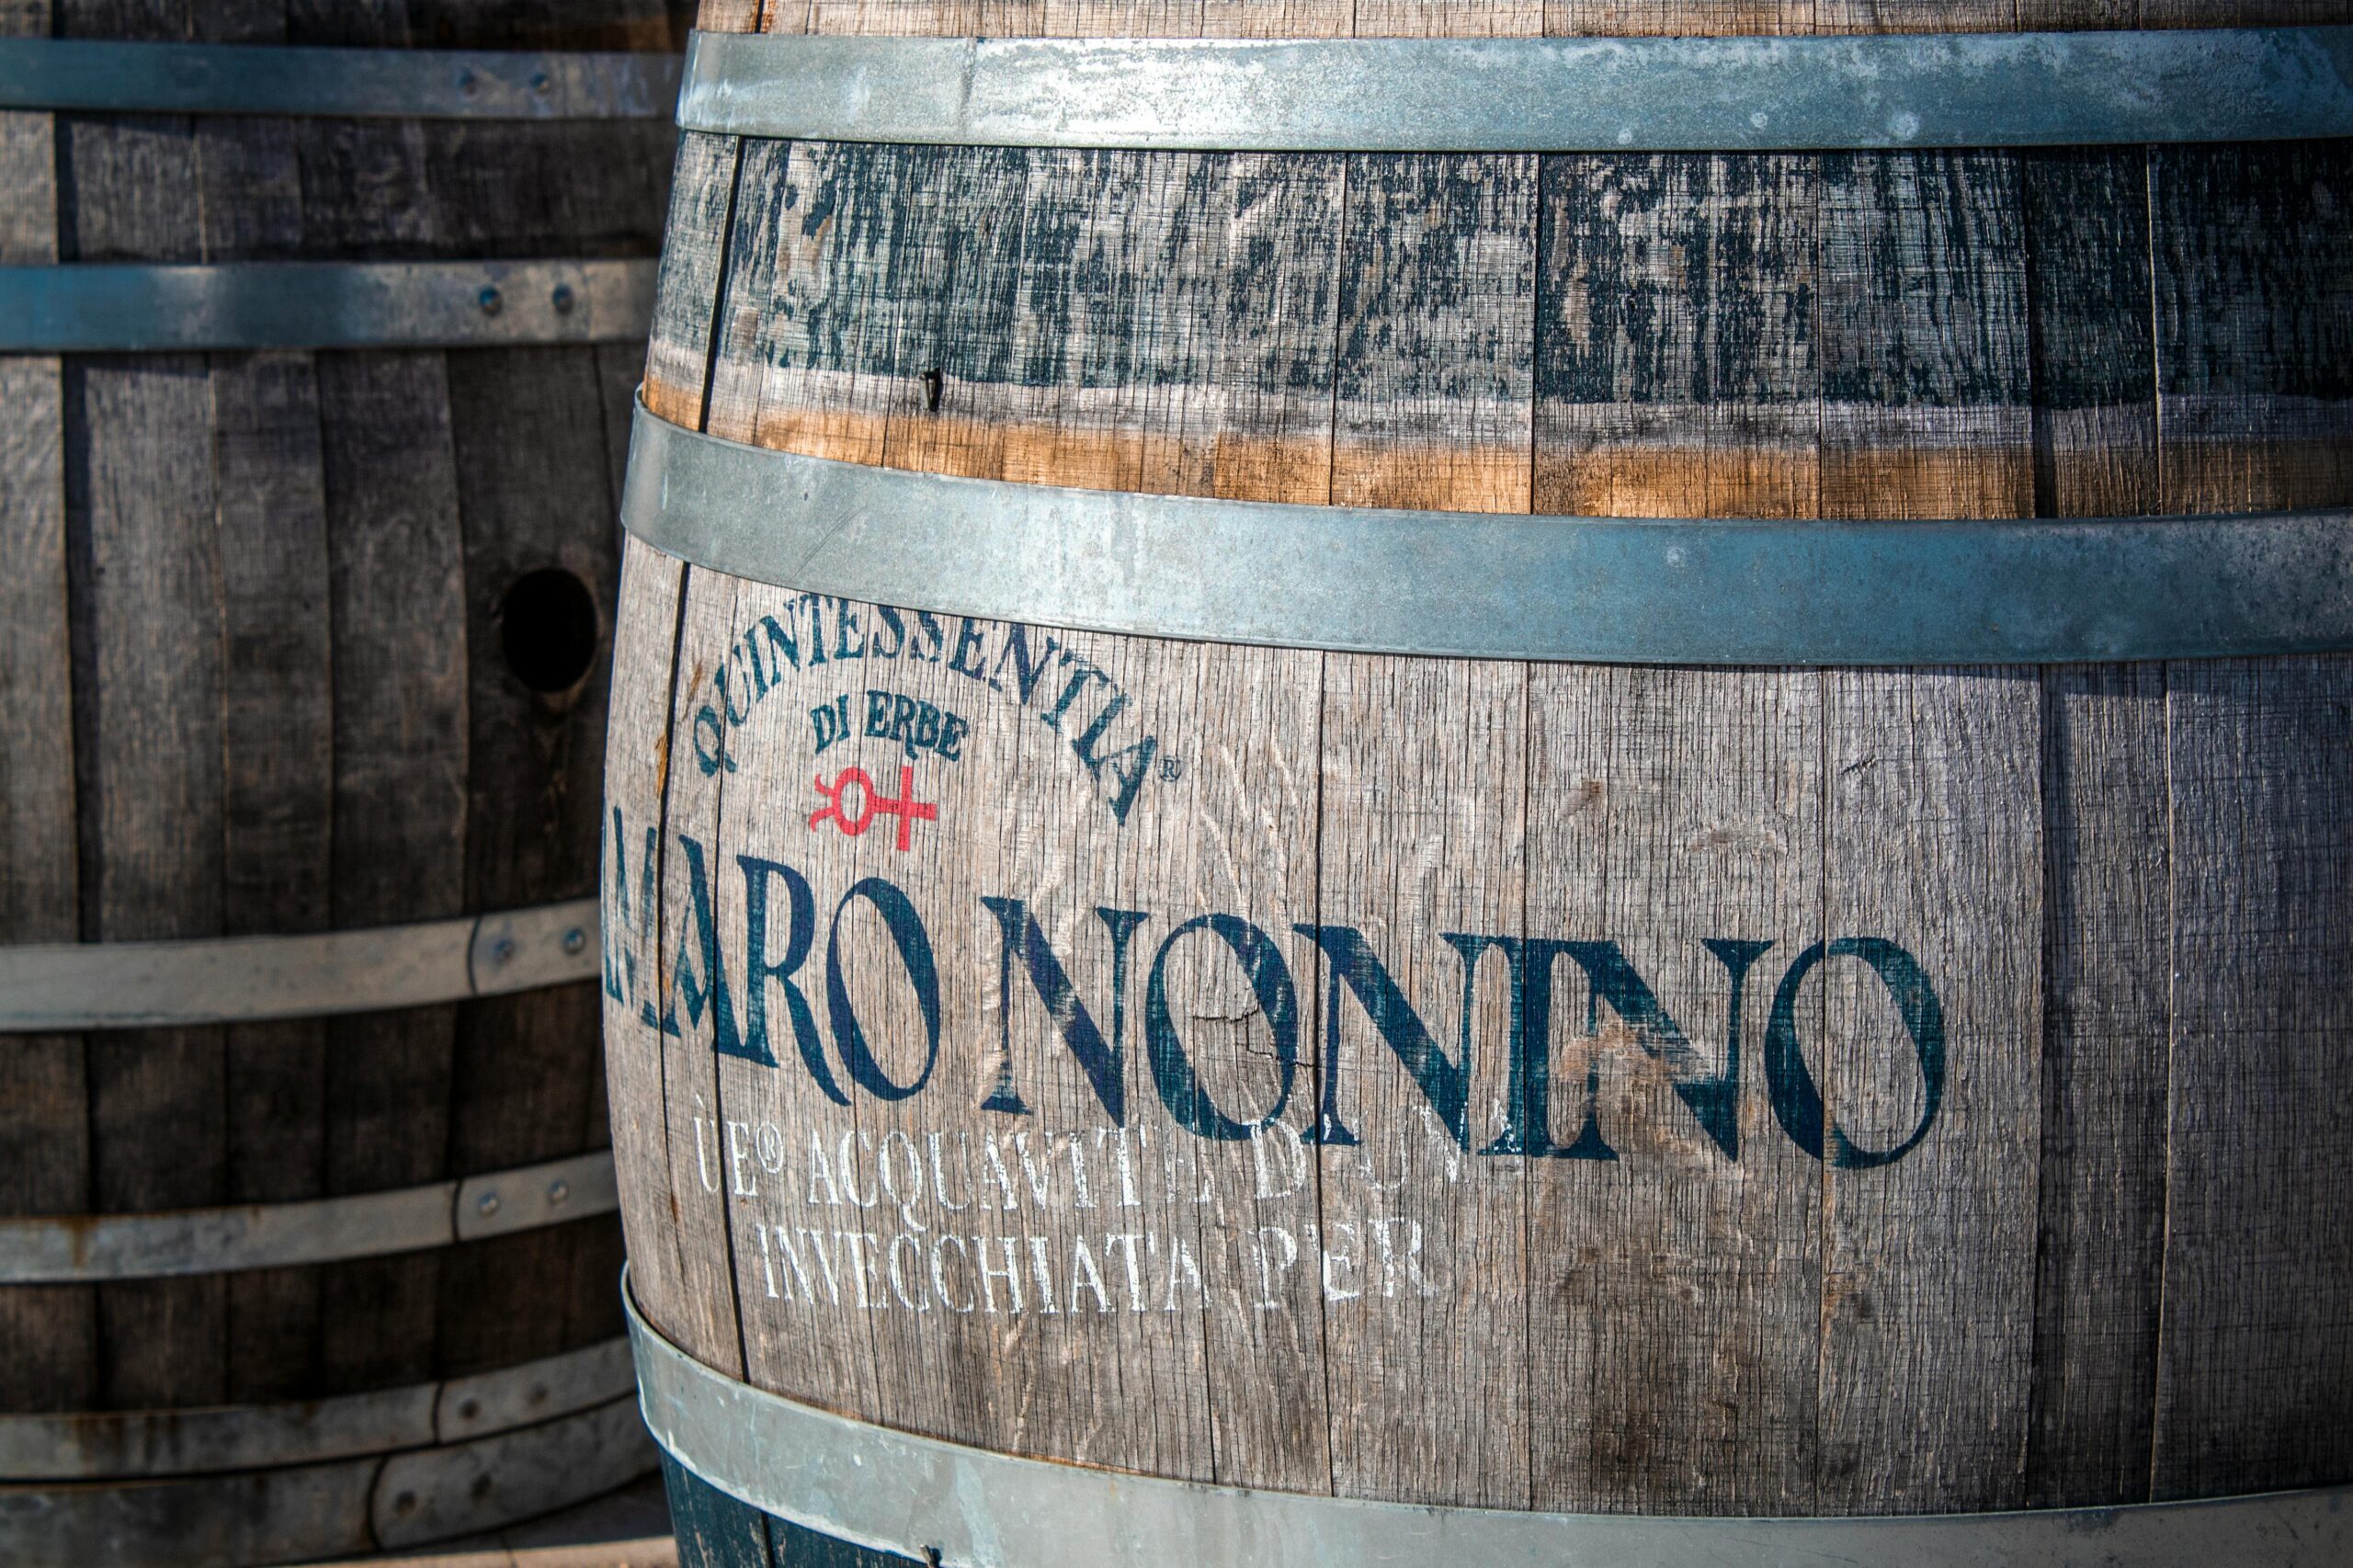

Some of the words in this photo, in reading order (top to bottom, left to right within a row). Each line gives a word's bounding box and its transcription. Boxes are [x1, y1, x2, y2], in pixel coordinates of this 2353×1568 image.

[809, 694, 851, 755] DI
[864, 689, 970, 762] ERBE
[602, 805, 940, 1106] MARO
[979, 895, 1945, 1170] NONINO
[756, 1222, 1213, 1314] INVECCHIATA
[1242, 1216, 1437, 1309] PER
